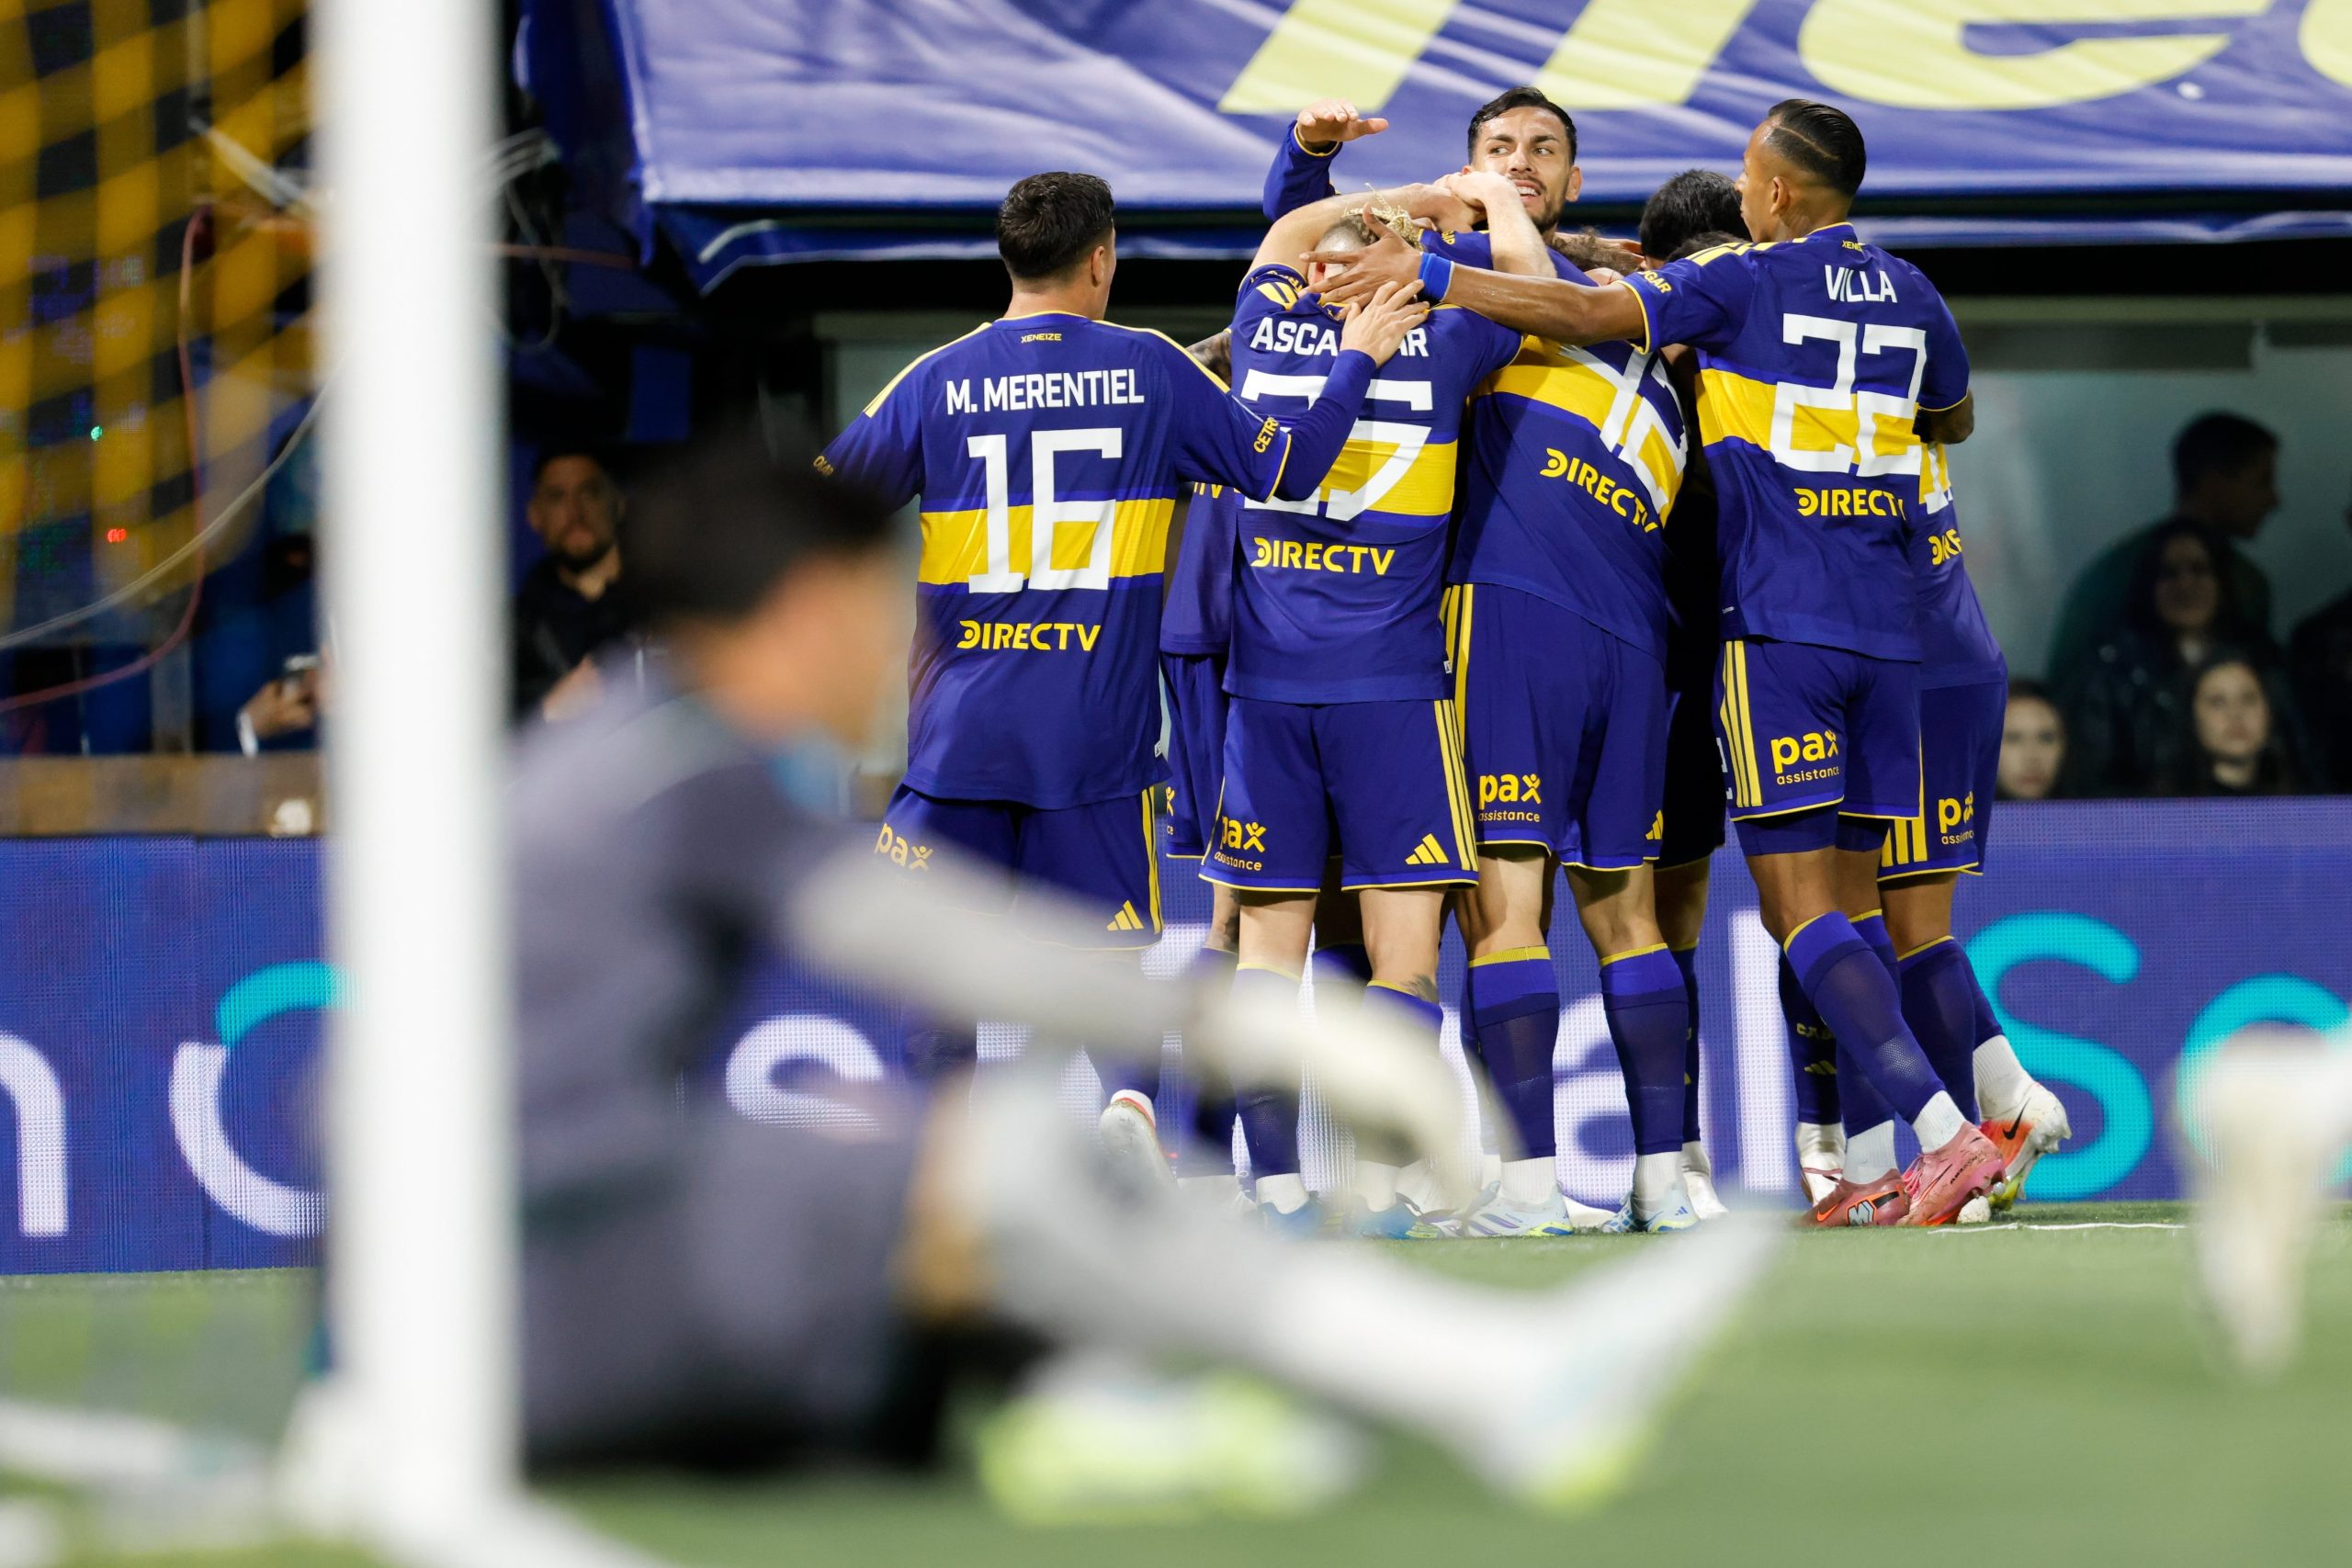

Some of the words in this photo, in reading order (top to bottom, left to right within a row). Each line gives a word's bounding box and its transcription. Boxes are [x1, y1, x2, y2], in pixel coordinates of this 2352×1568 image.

[1825, 265, 1897, 303] VILLA
[1021, 333, 1062, 344] XENEIZE
[946, 380, 978, 414] M.
[984, 369, 1145, 412] MERENTIEL
[1770, 313, 1927, 477] 22
[1253, 416, 1279, 453] CETR
[967, 427, 1123, 593] 16
[1251, 537, 1395, 575] DIRECTV
[956, 620, 1101, 651] DIRECTV
[1770, 729, 1838, 773] pax
[1478, 773, 1542, 810] pax
[1478, 810, 1541, 822] assistance
[874, 822, 933, 871] pax
